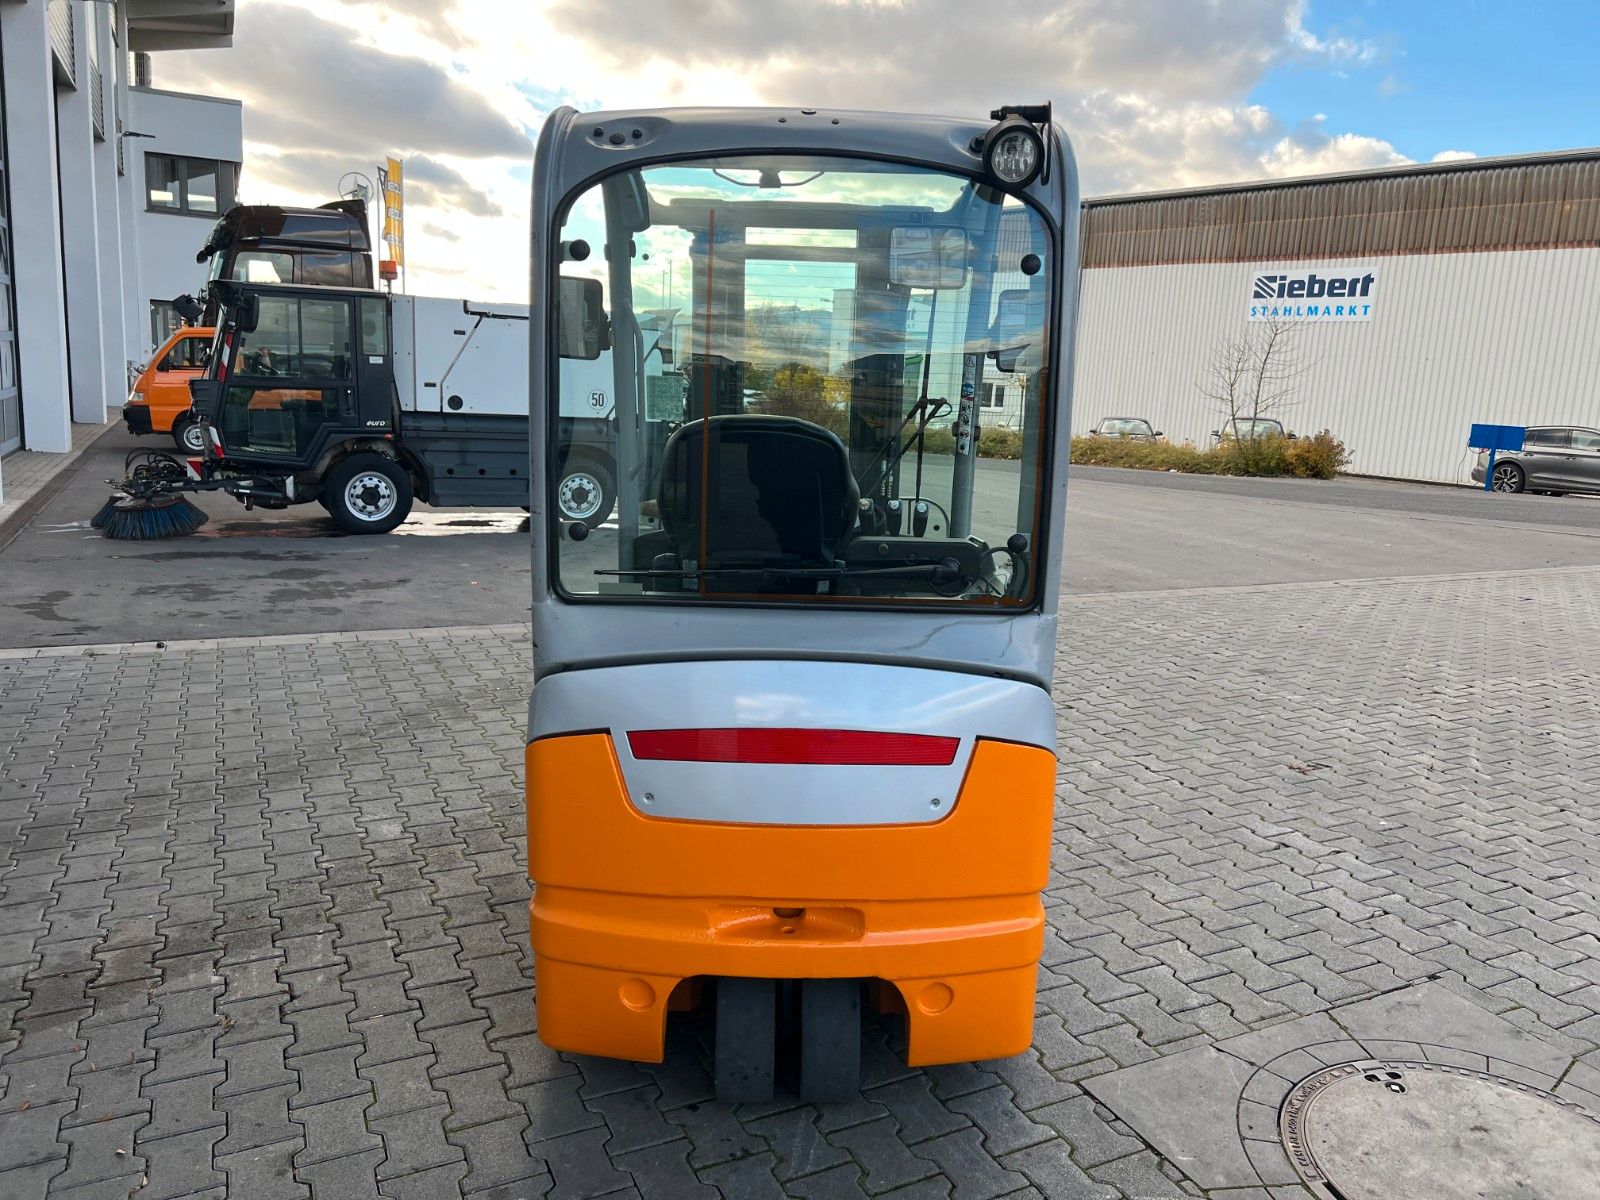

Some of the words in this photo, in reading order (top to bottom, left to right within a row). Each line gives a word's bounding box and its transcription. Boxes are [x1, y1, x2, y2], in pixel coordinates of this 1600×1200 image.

[1253, 272, 1375, 299] Siebert
[1250, 305, 1371, 317] STAHLMARKT
[591, 392, 604, 407] 50
